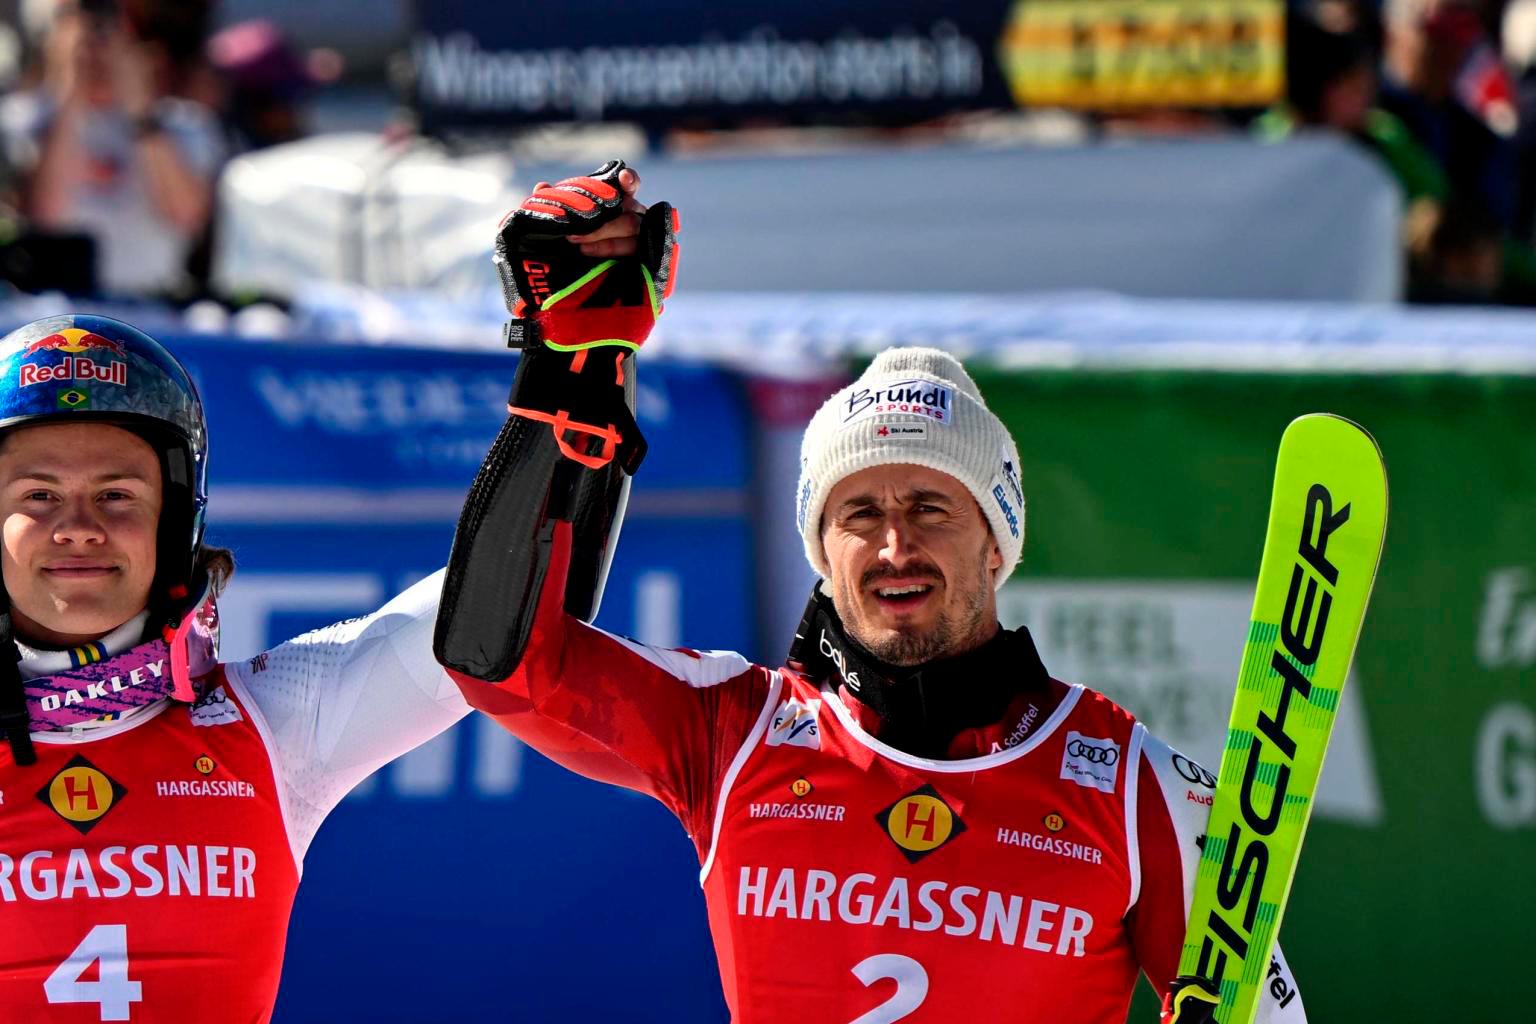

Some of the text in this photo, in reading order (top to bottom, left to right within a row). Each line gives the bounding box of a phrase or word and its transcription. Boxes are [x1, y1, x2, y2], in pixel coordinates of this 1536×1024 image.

[19, 357, 127, 387] Red Bull
[876, 404, 943, 420] SPORTS
[40, 658, 166, 712] OAKLEY
[156, 781, 255, 798] HARGASSNER
[1187, 790, 1214, 806] Aud
[750, 803, 845, 821] HARGASSNER
[997, 828, 1103, 864] HARGASSNER
[737, 866, 1094, 957] HARGASSNER
[43, 924, 142, 1022] 4
